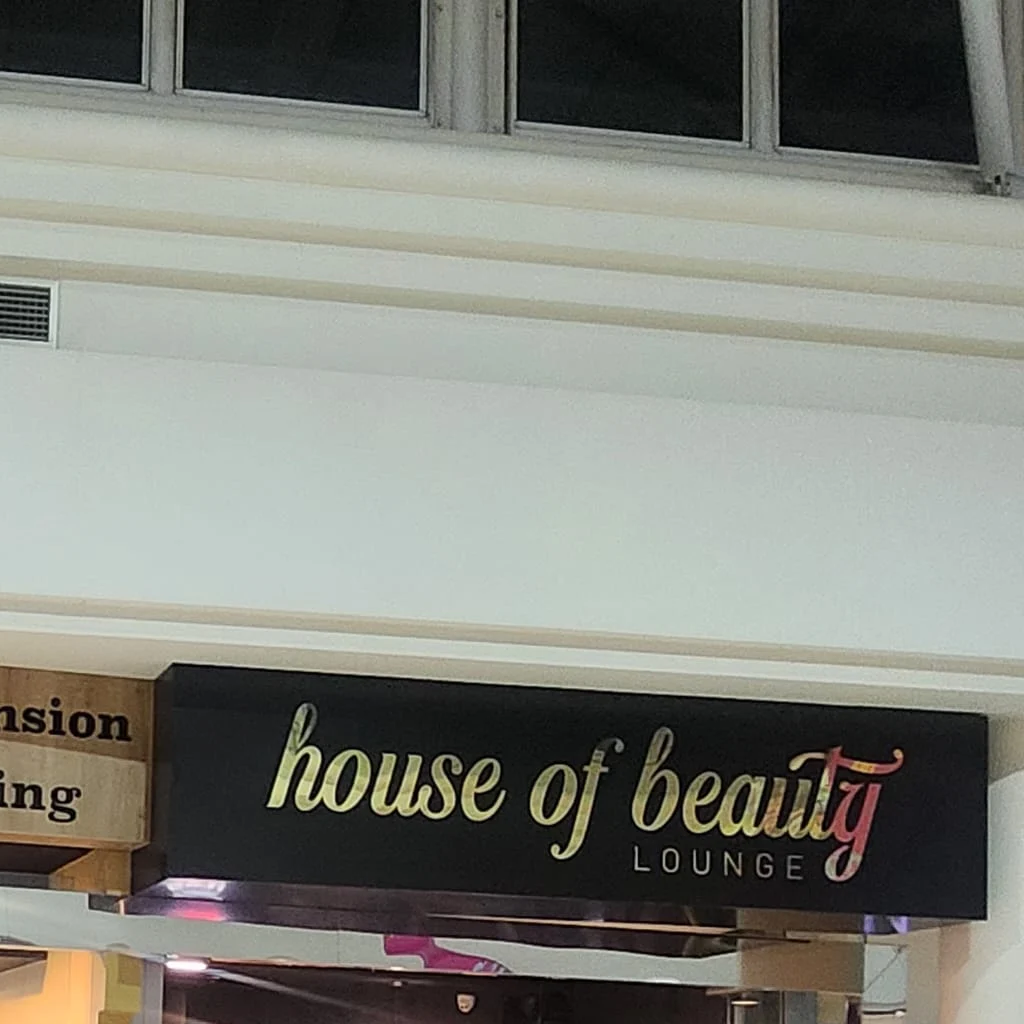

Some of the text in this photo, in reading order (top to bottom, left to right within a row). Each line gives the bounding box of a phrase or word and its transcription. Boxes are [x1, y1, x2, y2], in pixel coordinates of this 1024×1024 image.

[267, 702, 905, 883] house of beauty
[633, 845, 805, 881] LOUNGE
